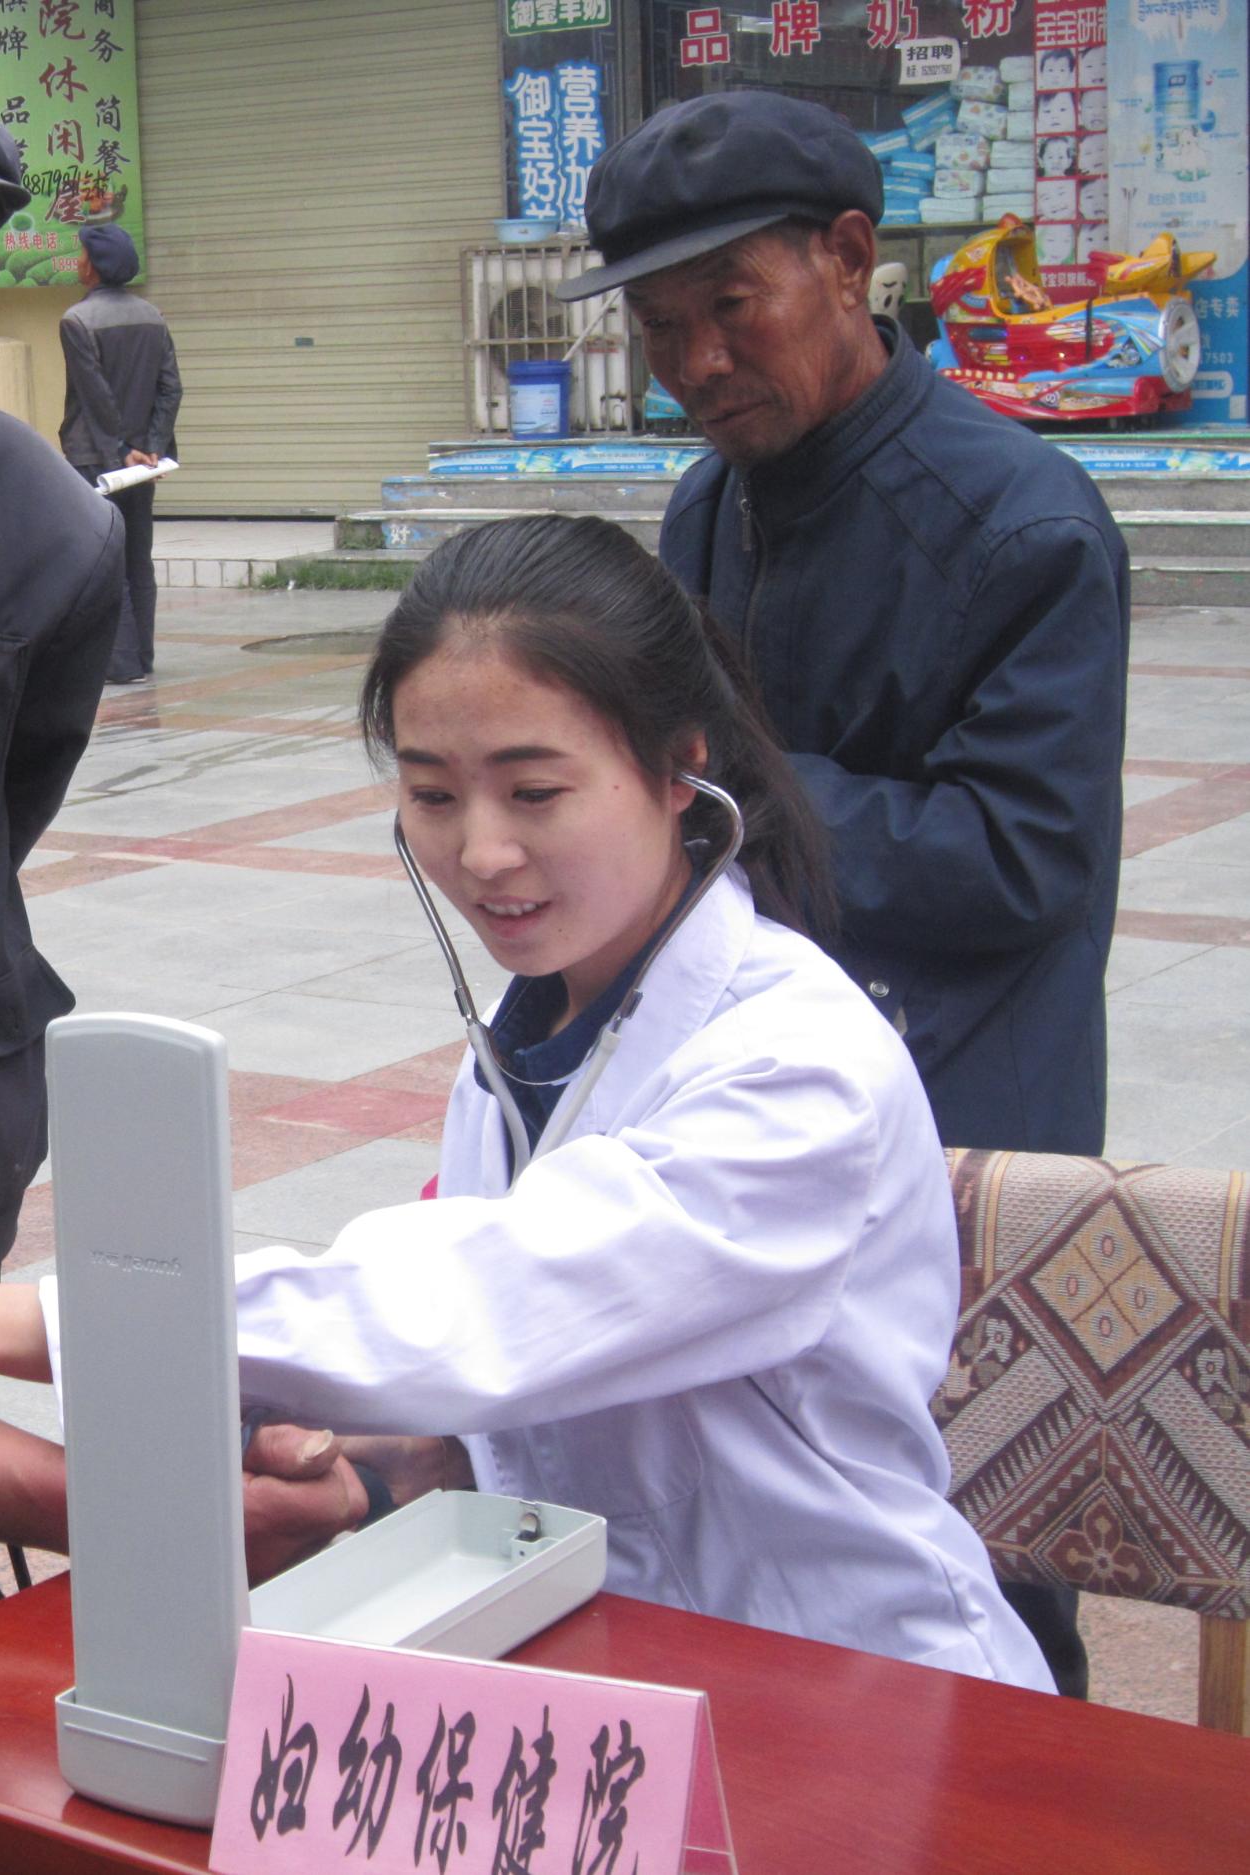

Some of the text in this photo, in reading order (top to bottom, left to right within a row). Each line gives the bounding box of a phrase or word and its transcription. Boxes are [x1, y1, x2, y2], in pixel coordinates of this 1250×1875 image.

[511, 0, 607, 29] 御宝羊奶
[680, 0, 1016, 67] 品牌奶粉
[906, 44, 954, 61] 招聘
[558, 65, 602, 228] 营养加
[250, 1673, 647, 1875] 妇幼保健院
